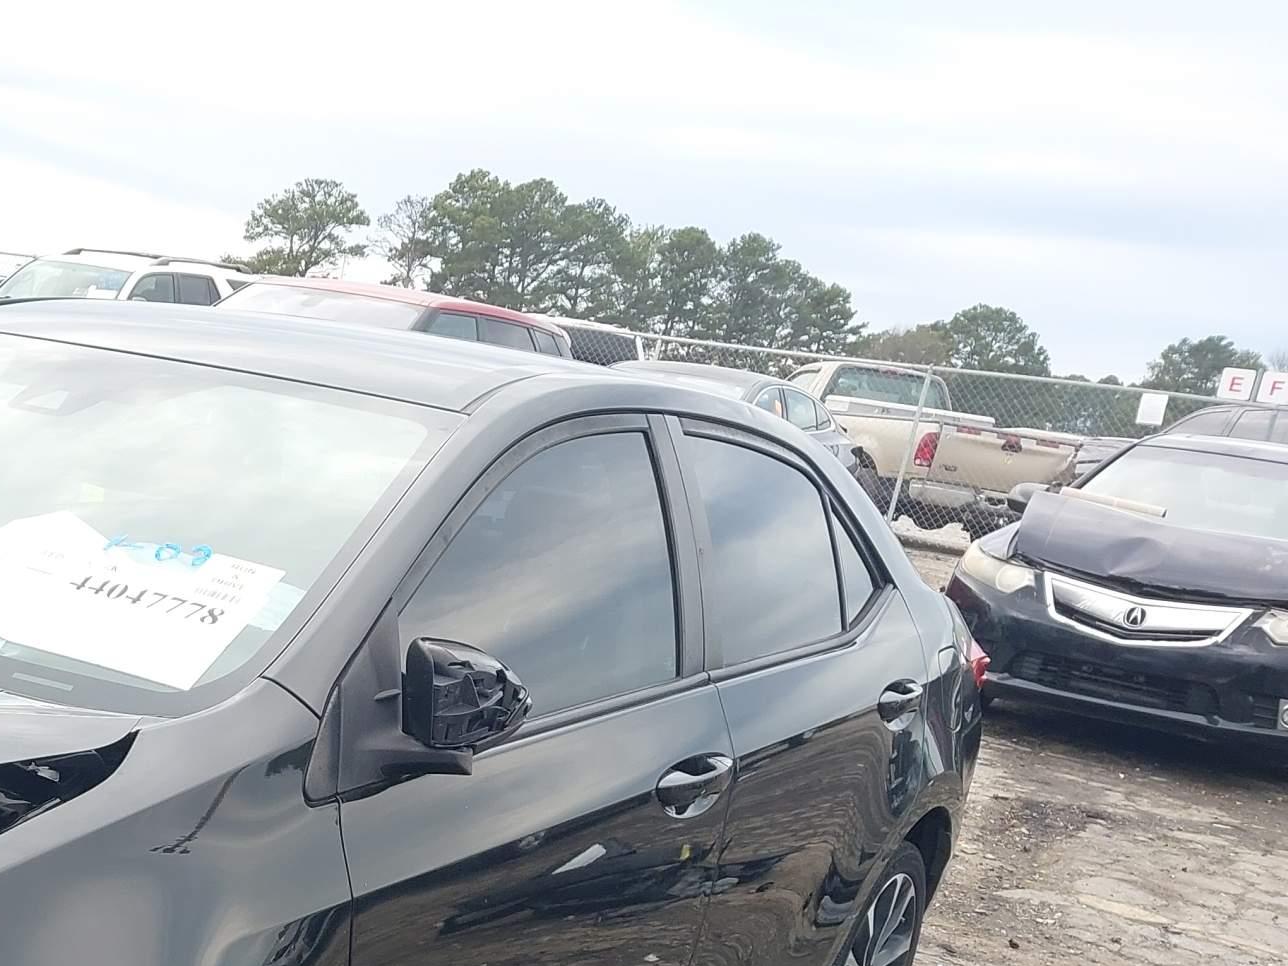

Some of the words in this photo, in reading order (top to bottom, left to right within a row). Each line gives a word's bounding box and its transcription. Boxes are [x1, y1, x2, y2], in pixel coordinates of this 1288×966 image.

[1228, 376, 1245, 392] E
[1269, 380, 1286, 396] F
[69, 575, 225, 625] 44047778
